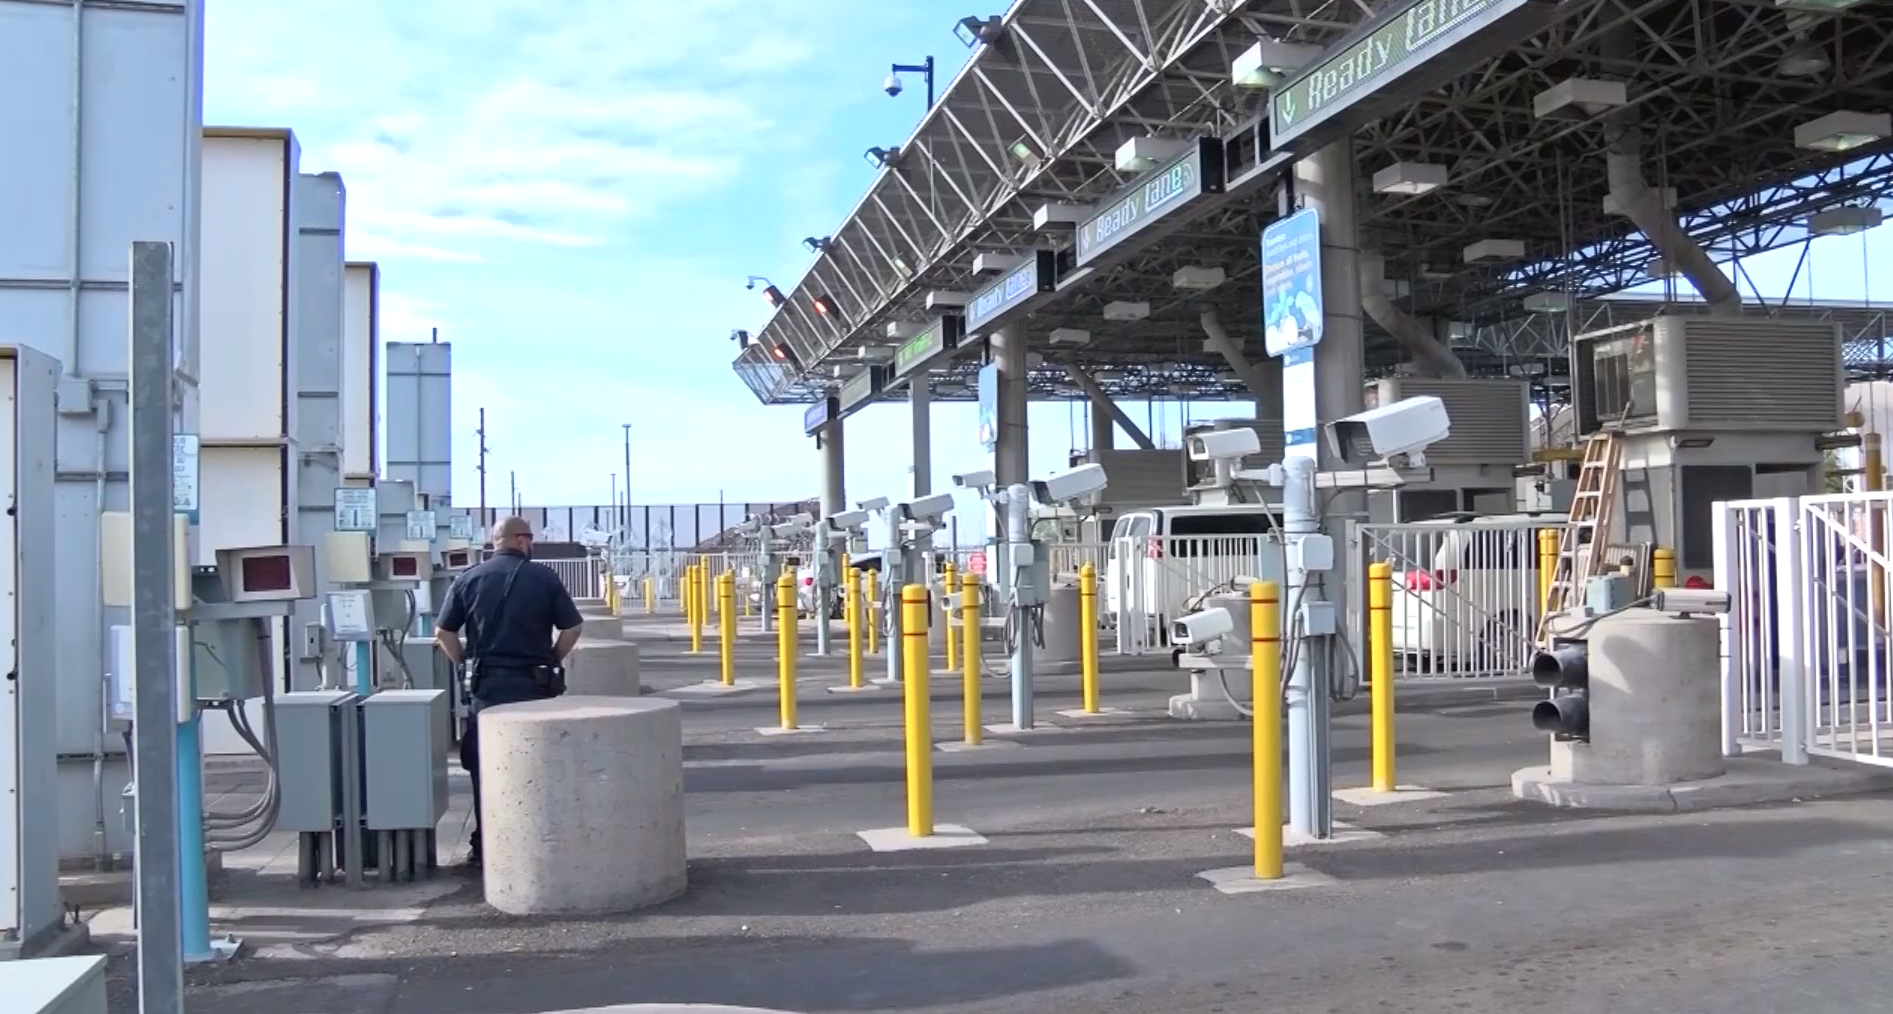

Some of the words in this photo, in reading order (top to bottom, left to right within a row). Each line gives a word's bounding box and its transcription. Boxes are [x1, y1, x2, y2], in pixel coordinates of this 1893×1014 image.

[1308, 33, 1392, 110] Ready
[1405, 0, 1488, 51] Lan
[1096, 197, 1140, 242] Ready
